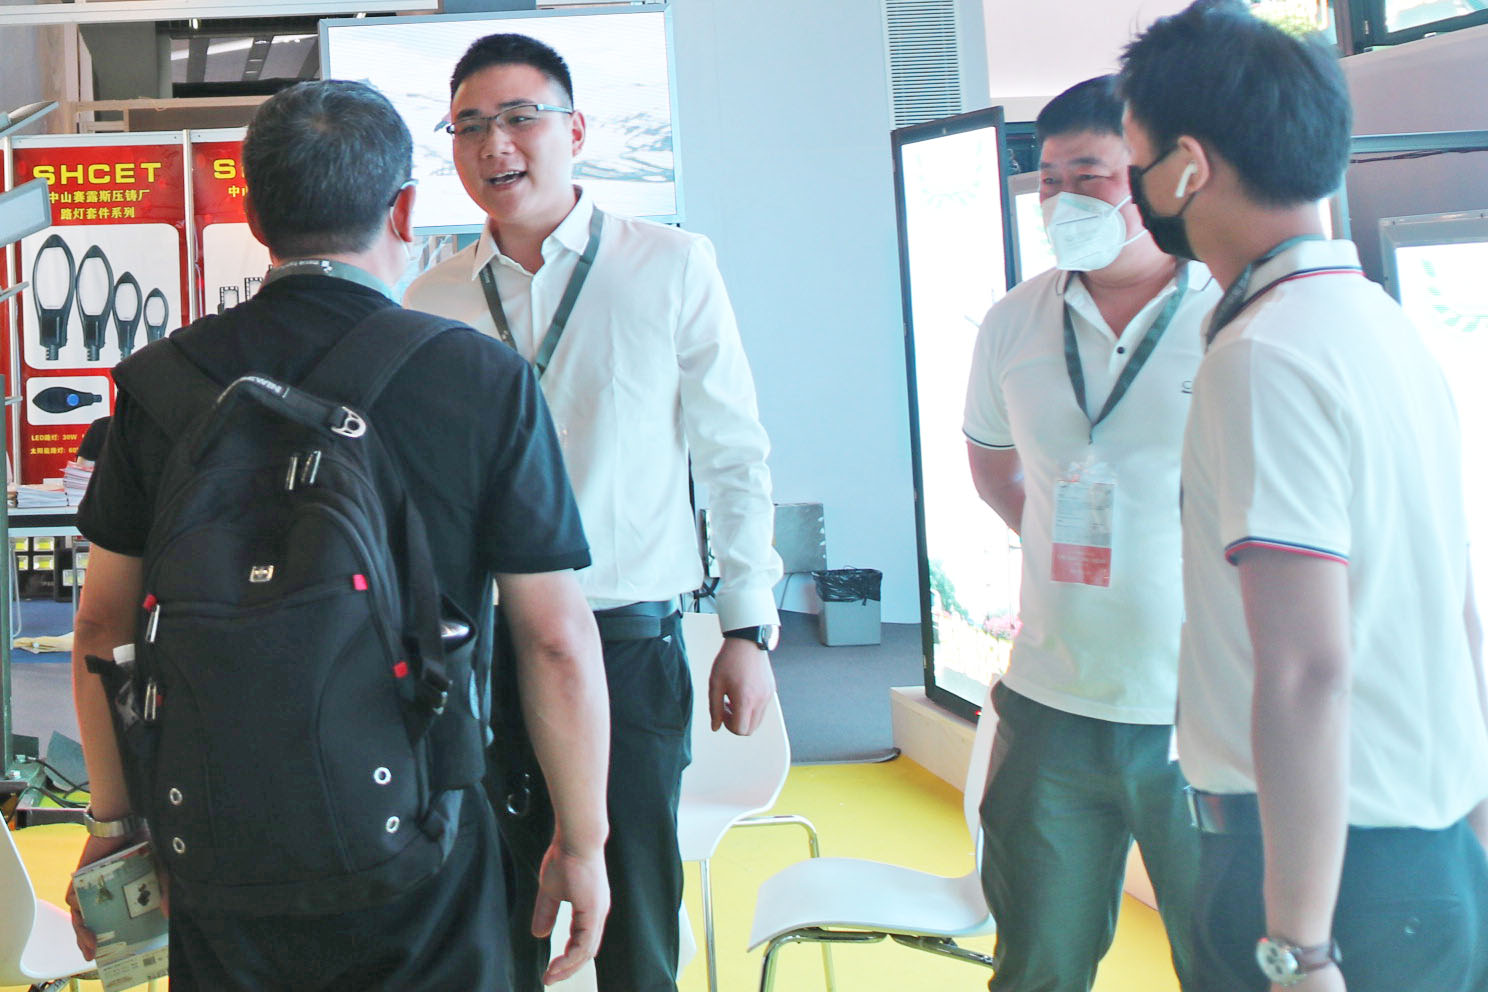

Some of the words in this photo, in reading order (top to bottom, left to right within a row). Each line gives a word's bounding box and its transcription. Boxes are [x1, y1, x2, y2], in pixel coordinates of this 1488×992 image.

[32, 162, 162, 186] SHCET
[60, 207, 136, 220] 路灯套件系列
